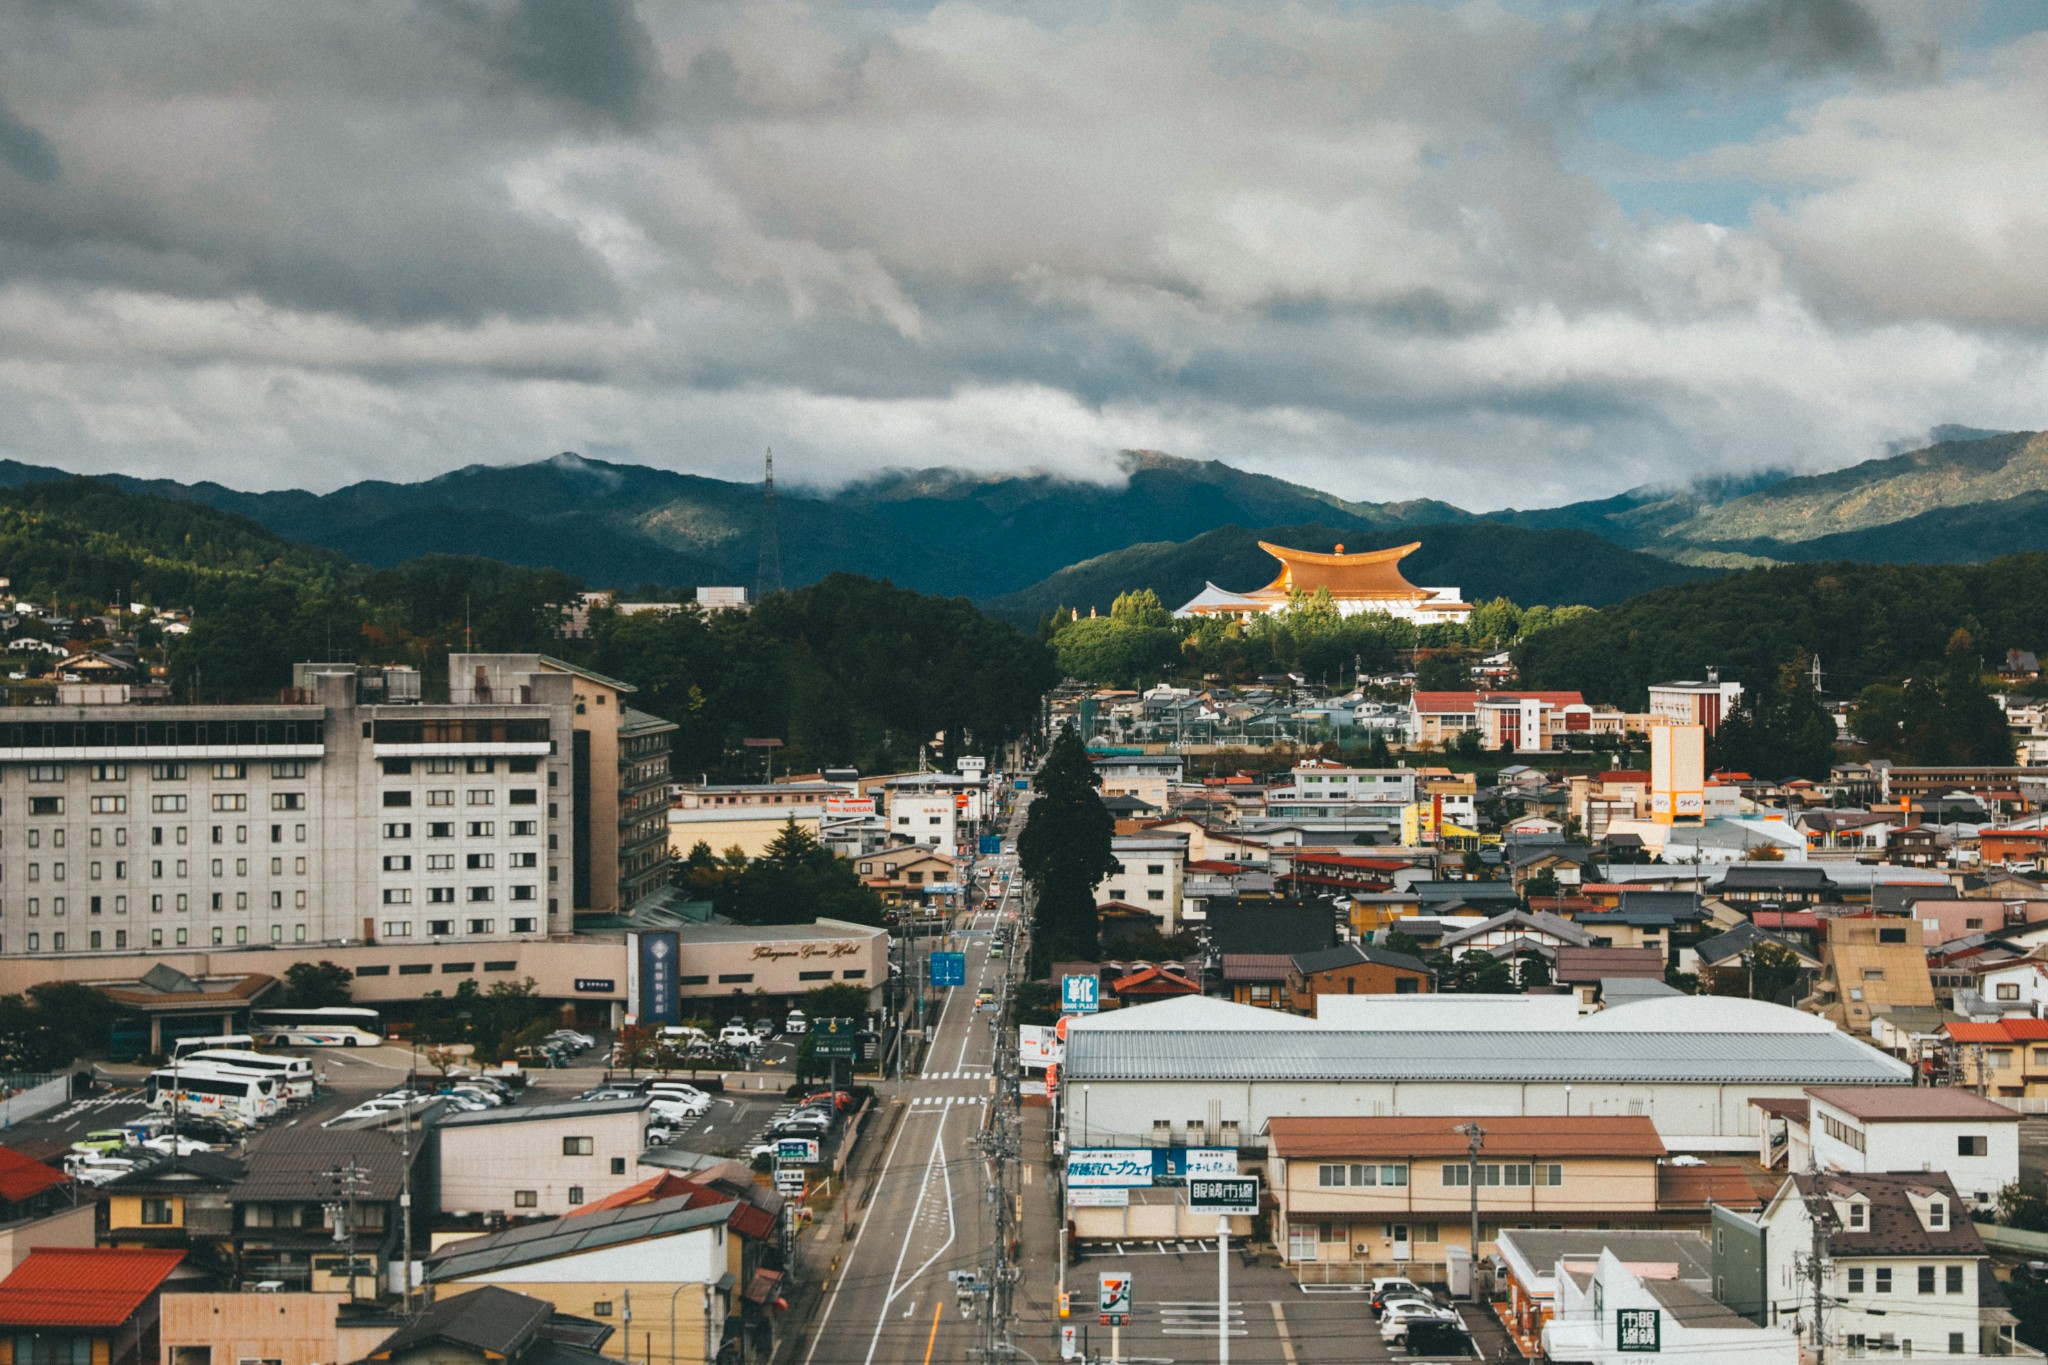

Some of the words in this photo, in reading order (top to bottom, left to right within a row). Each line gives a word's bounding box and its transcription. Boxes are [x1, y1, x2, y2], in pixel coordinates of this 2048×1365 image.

[829, 943, 862, 958] Hotel
[1067, 978, 1094, 1003] 靴
[1193, 1182, 1253, 1198] 眼鏡市場
